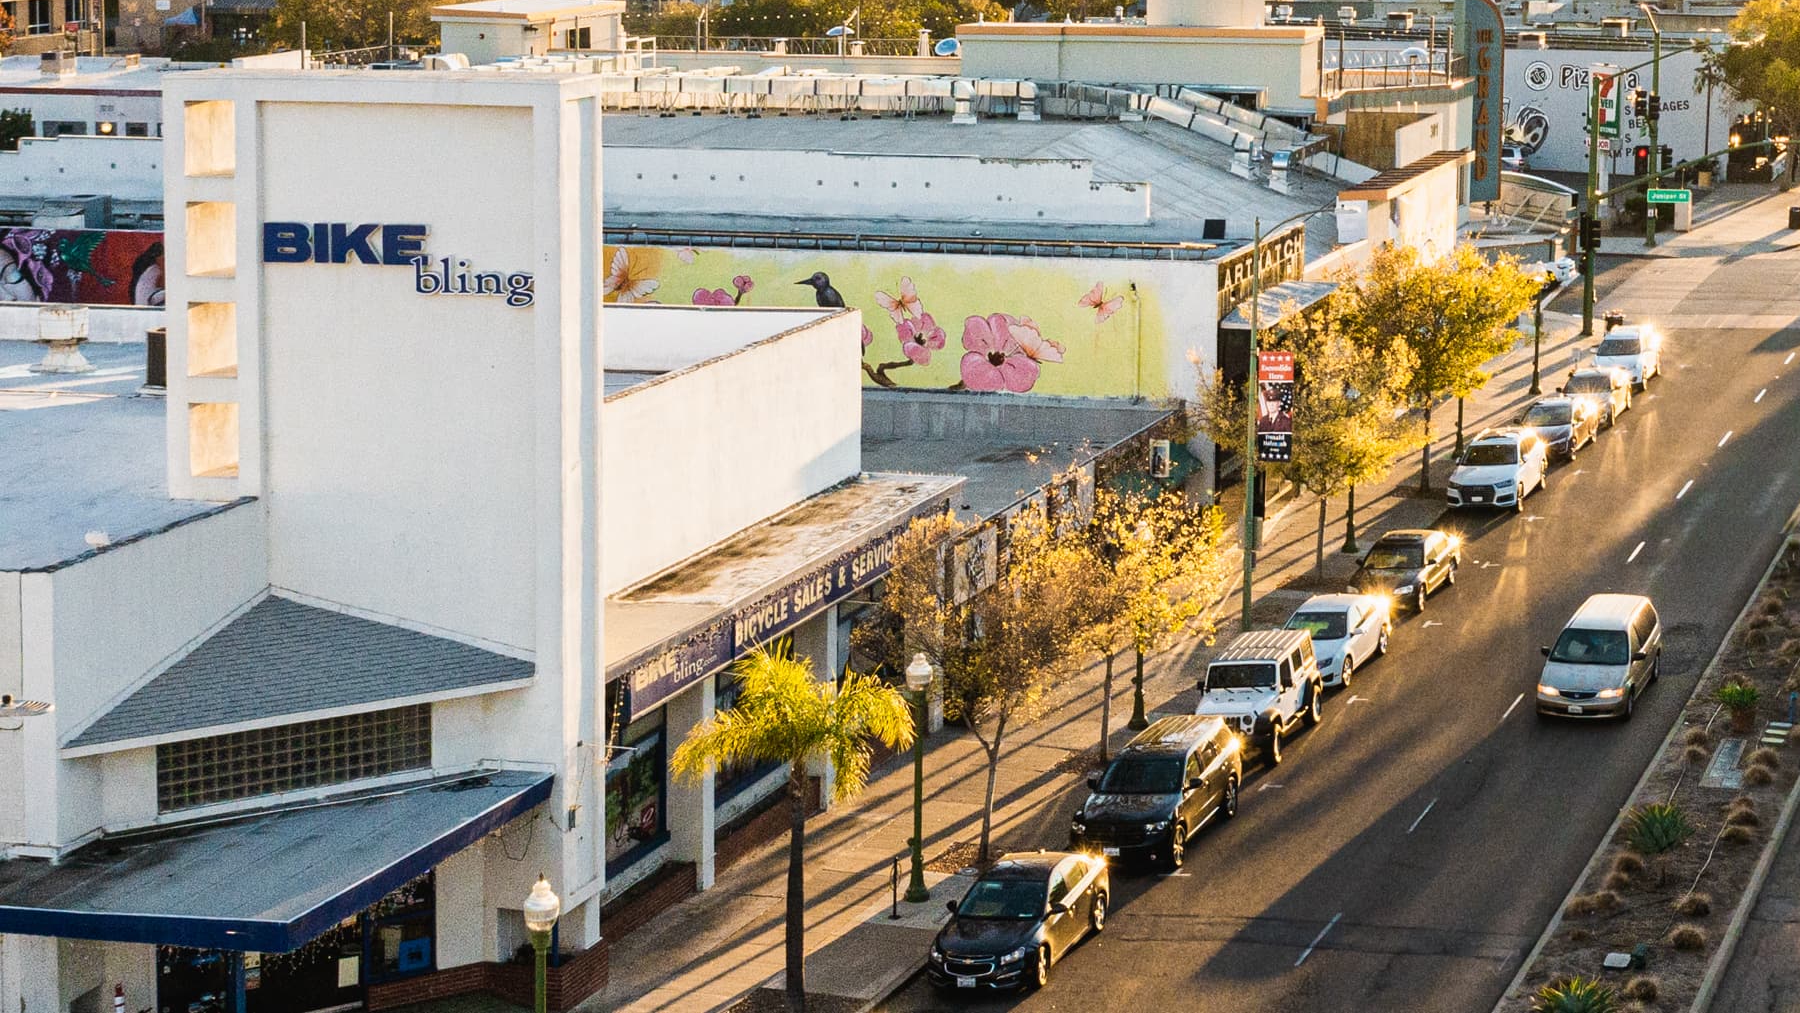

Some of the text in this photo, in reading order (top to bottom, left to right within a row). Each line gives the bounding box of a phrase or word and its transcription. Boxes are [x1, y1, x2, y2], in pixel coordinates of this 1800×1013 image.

[1560, 66, 1638, 89] Piza
[1474, 46, 1491, 181] GRAND
[264, 222, 431, 266] BIKE
[411, 255, 535, 307] bling
[735, 596, 789, 648] BICYCLE
[794, 572, 832, 613] SALES
[838, 565, 846, 589] &
[635, 648, 677, 692] BIKE
